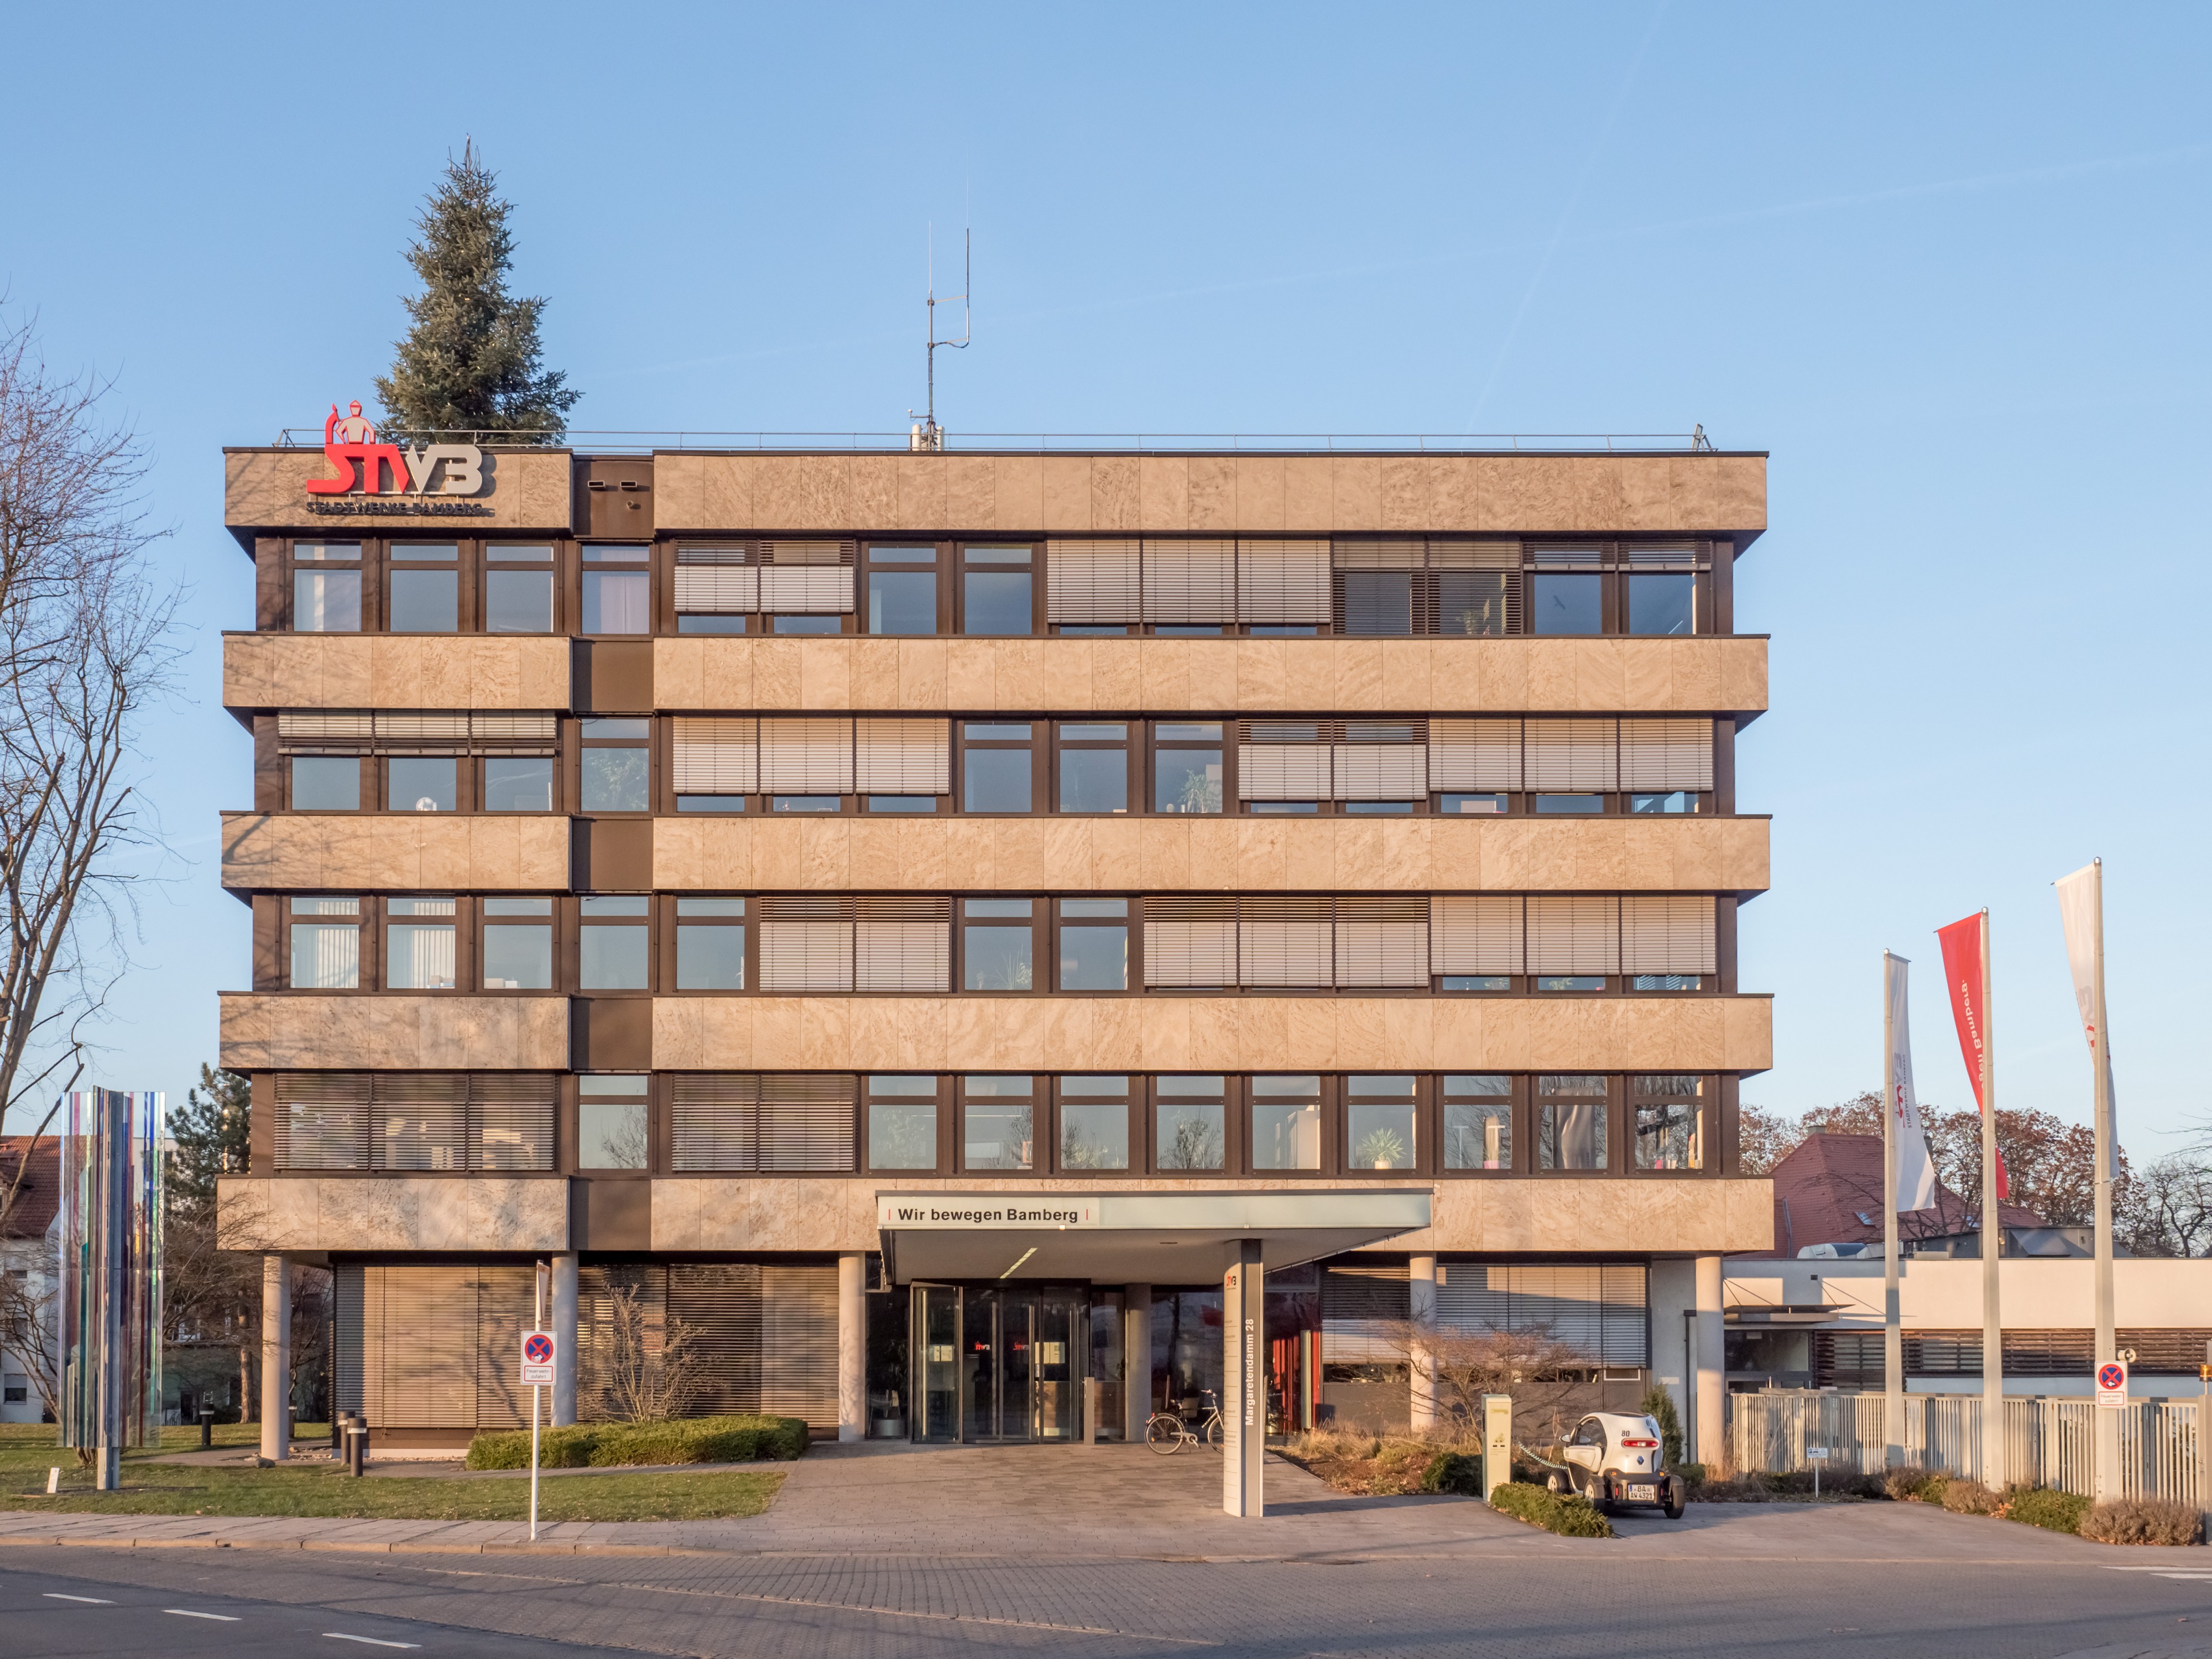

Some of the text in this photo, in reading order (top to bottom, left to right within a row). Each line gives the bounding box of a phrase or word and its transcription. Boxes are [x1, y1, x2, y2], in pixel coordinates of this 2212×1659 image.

[306, 502, 483, 514] STADTWERKE BAMBERG
[898, 1209, 1078, 1223] Wir bewegen Bamberg
[1245, 1318, 1255, 1426] Margaretendamm 28
